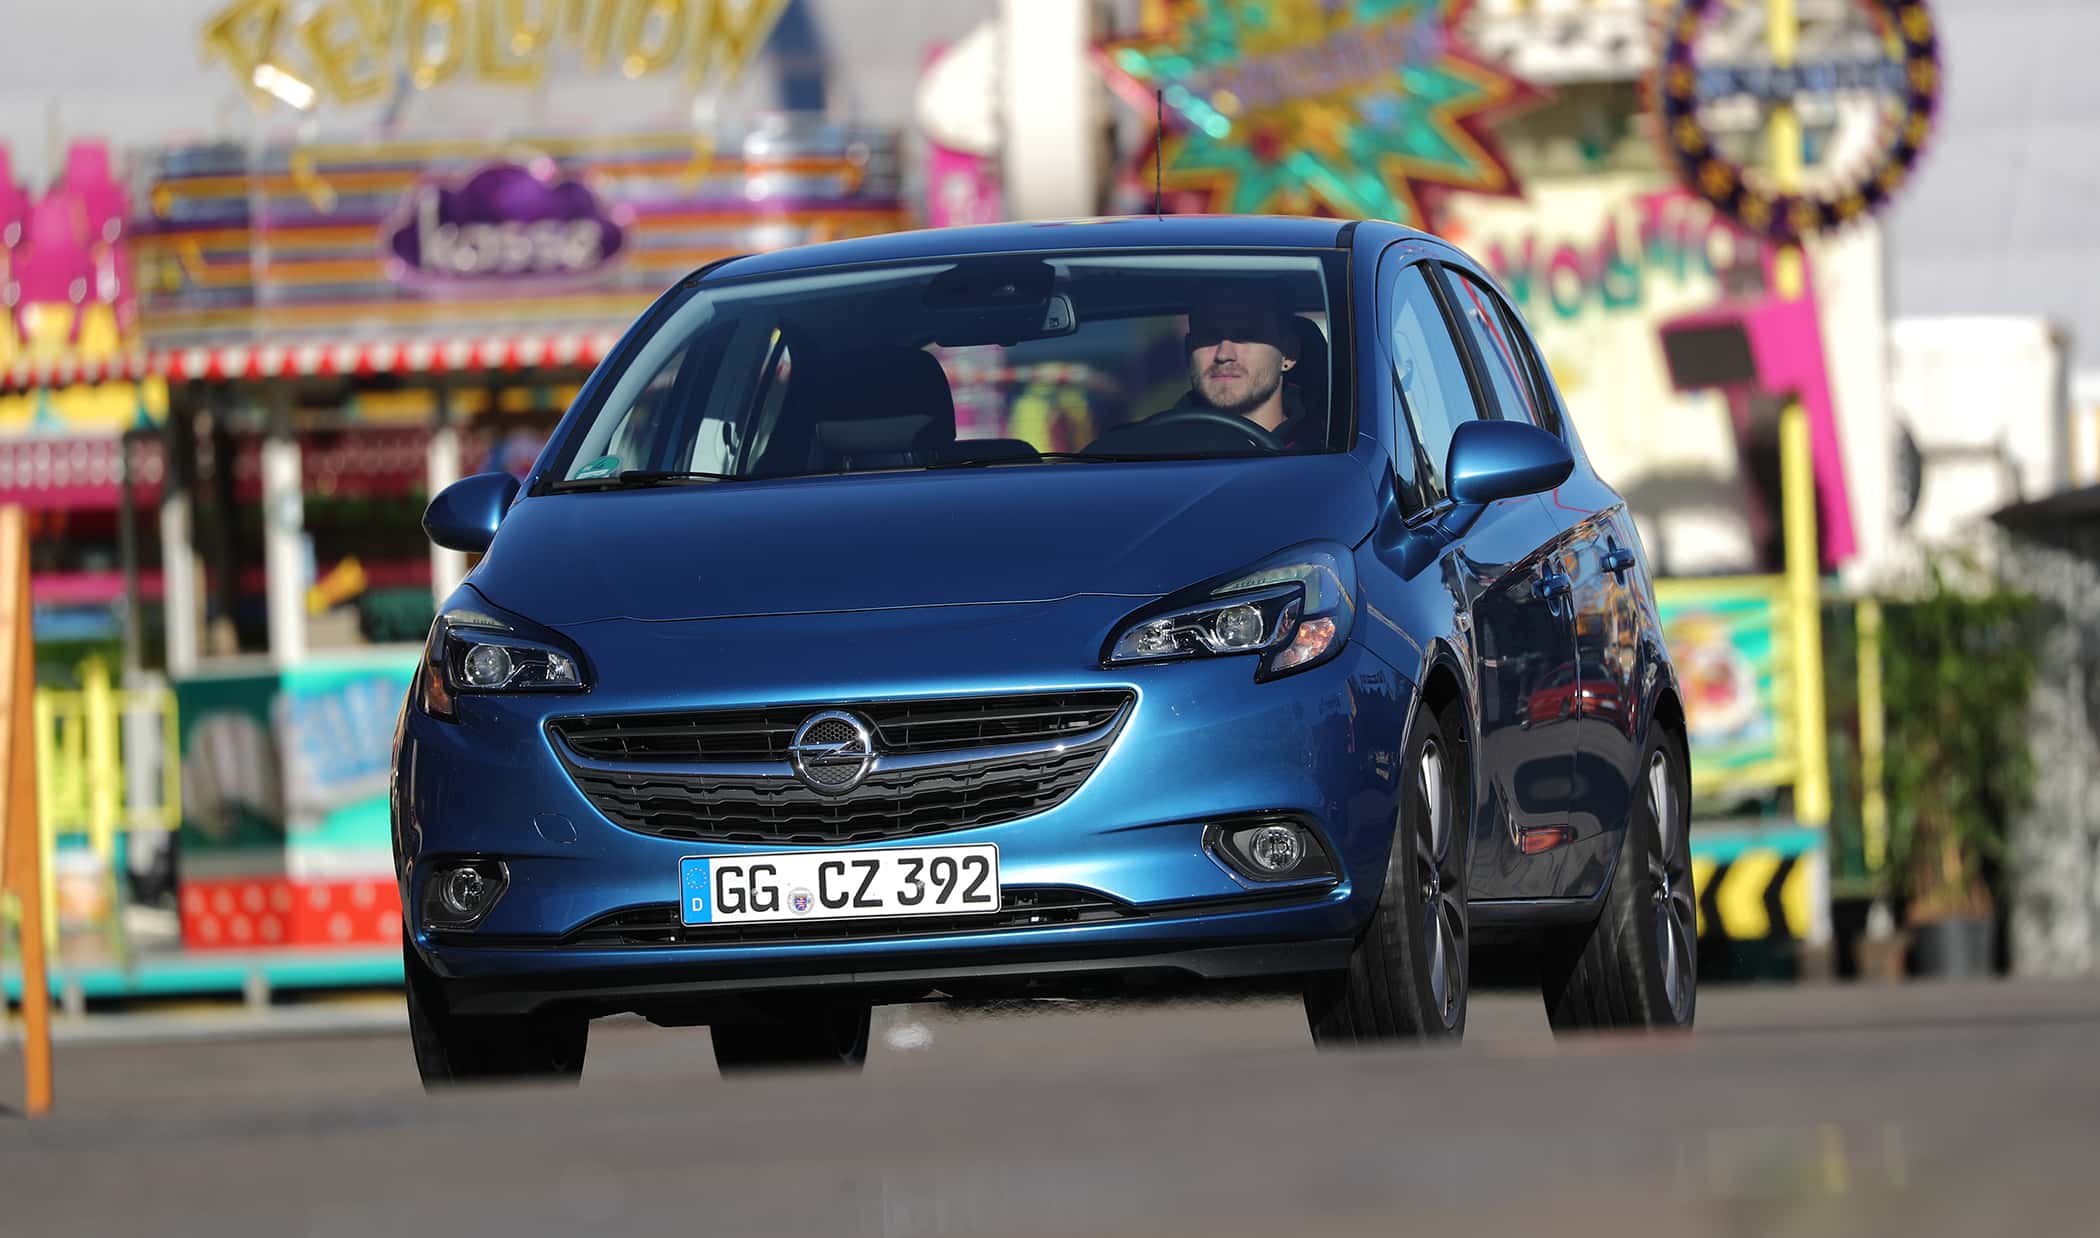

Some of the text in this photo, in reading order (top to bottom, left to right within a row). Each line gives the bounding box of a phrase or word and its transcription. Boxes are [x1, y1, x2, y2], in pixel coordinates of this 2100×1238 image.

[716, 855, 992, 913] GG CZ 392
[692, 898, 703, 912] D
